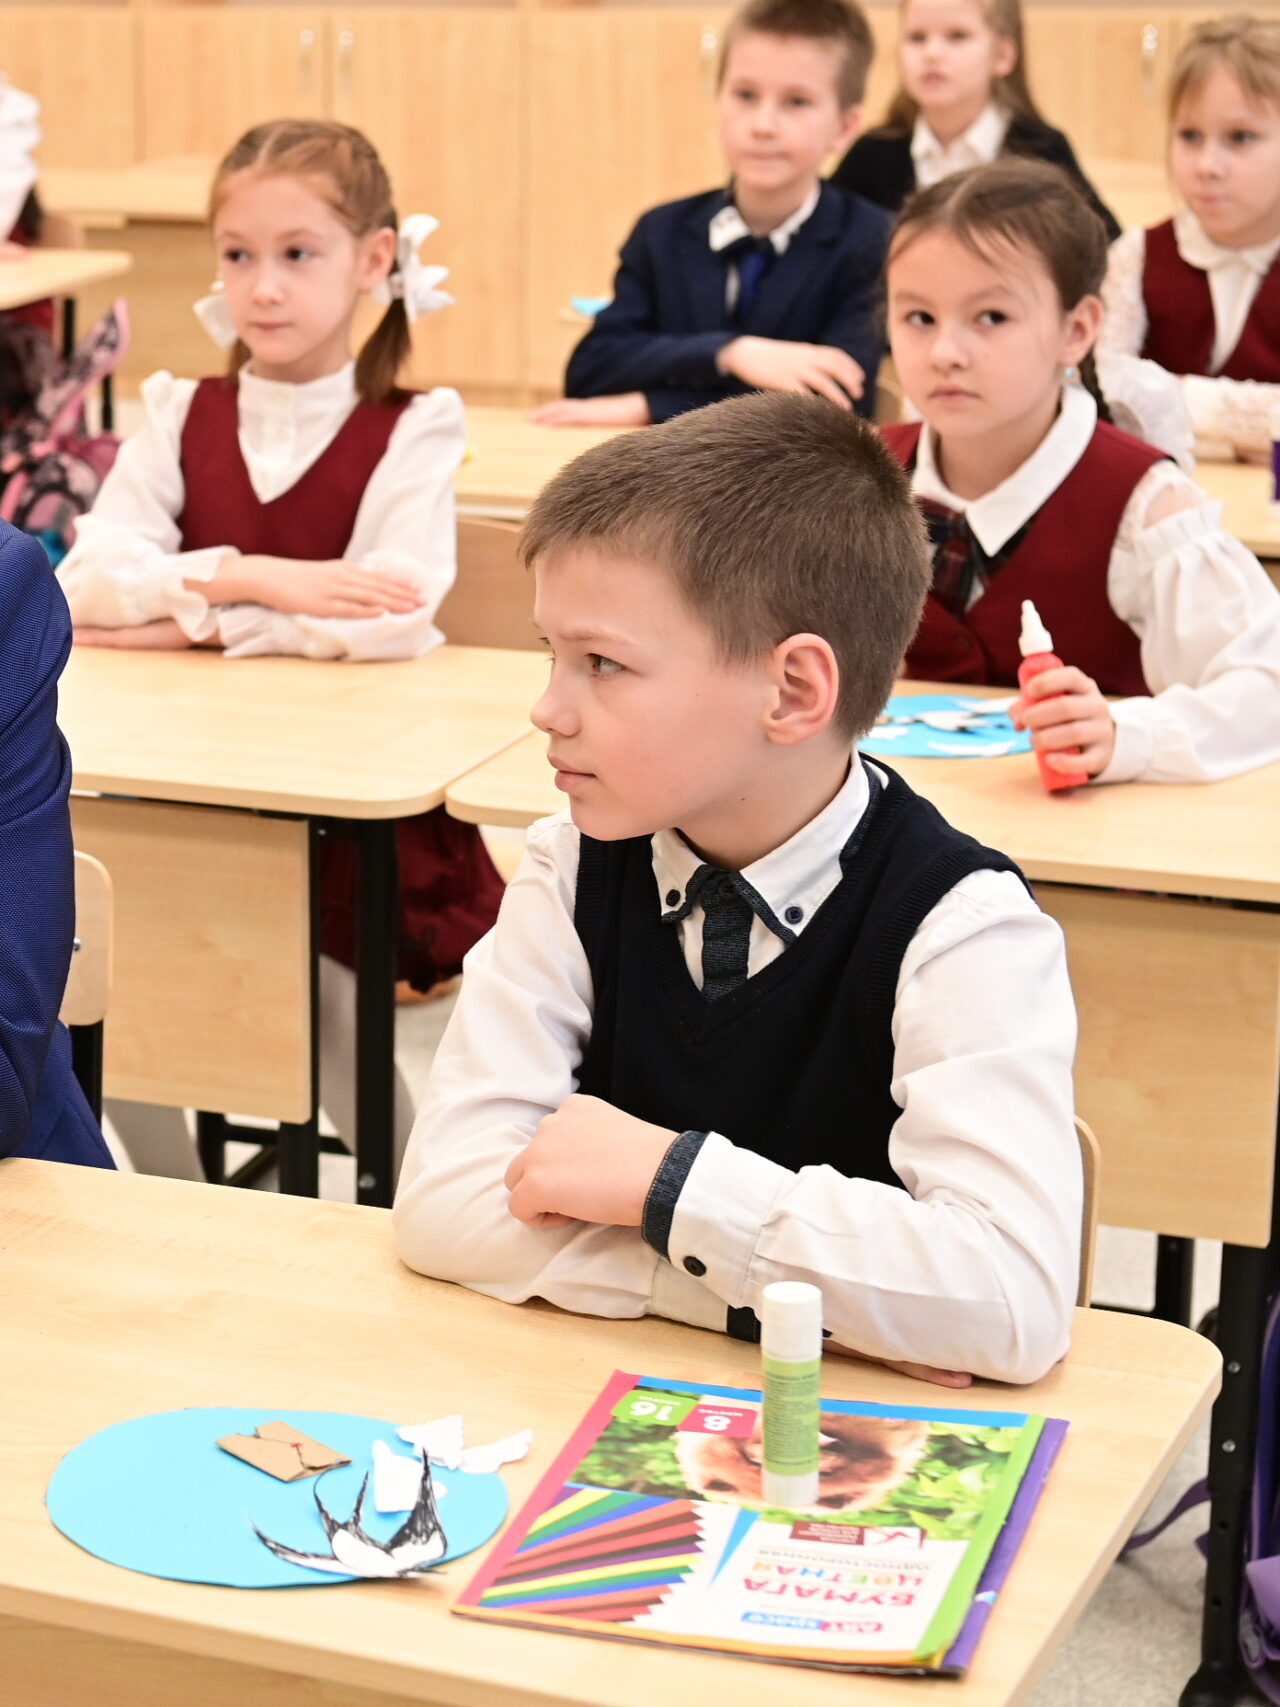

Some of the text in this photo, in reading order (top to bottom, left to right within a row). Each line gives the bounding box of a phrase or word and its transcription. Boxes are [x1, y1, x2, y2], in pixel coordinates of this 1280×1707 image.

[630, 1401, 673, 1421] 16
[703, 1415, 731, 1431] 8
[752, 1562, 922, 1587] ЦВЕТНАЯ
[743, 1578, 916, 1607] БУМАГА
